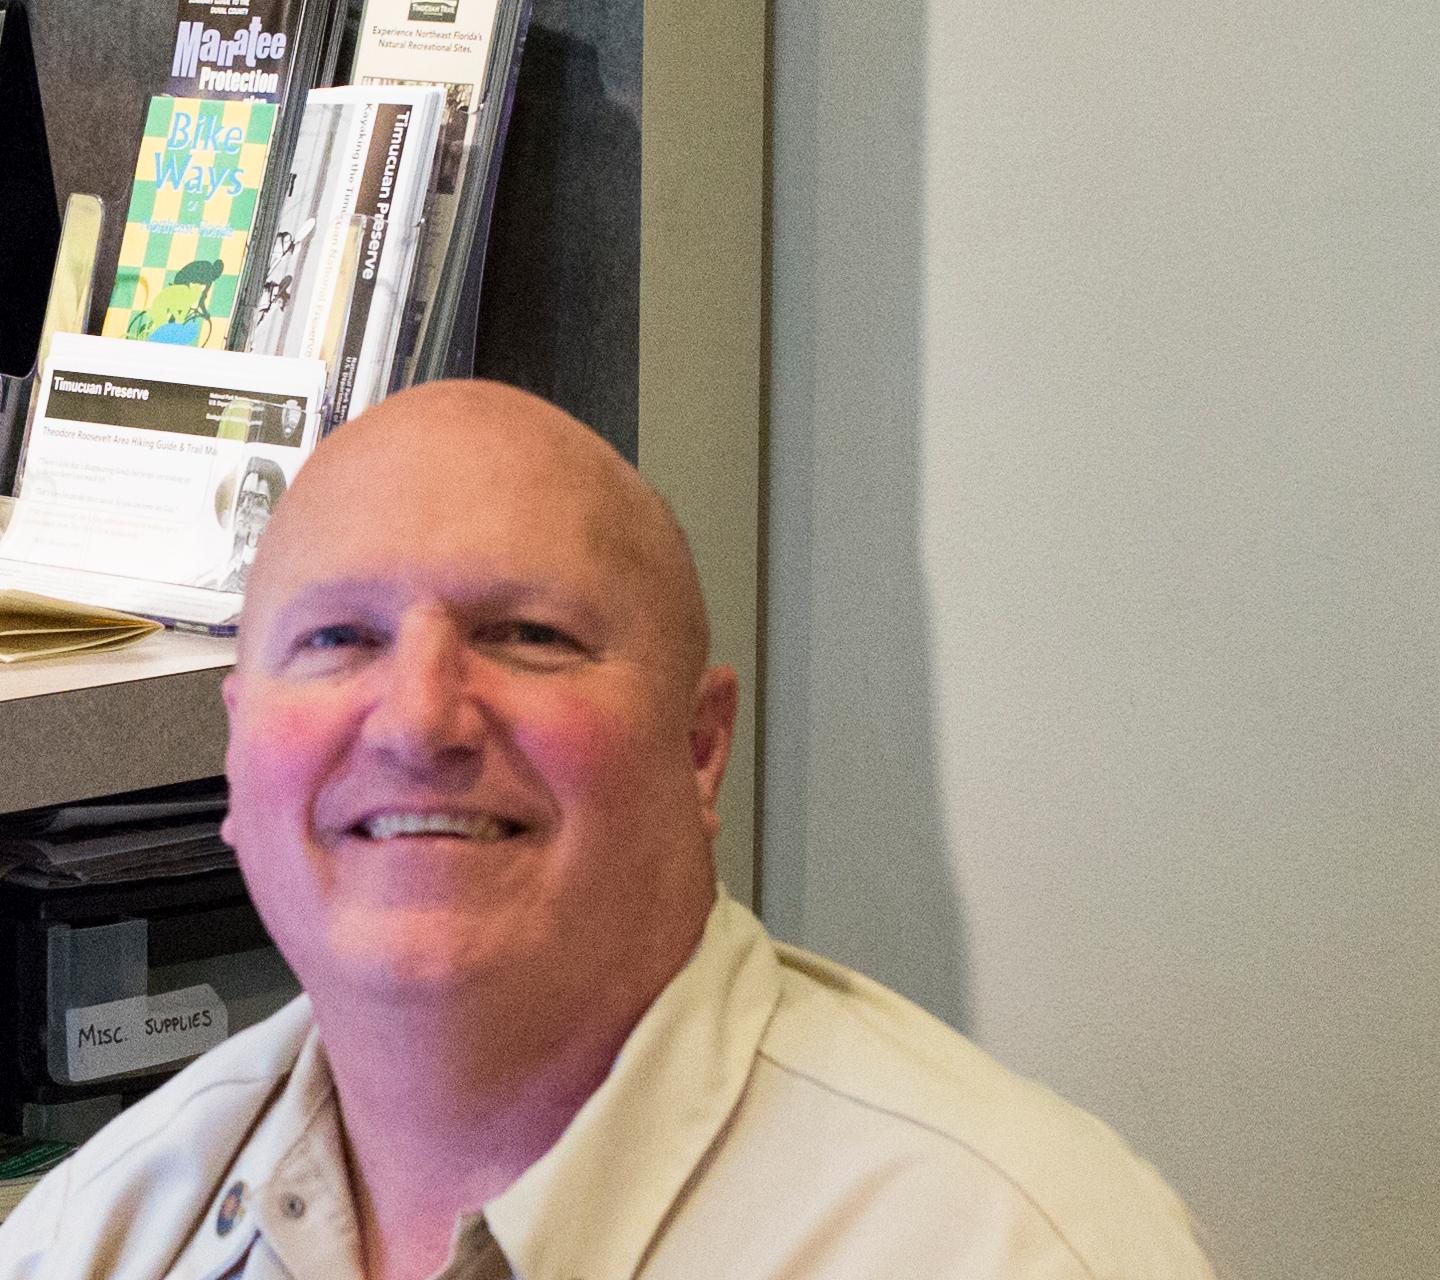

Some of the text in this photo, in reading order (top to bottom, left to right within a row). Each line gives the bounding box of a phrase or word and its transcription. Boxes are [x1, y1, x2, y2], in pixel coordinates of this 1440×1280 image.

[171, 16, 287, 78] Manatee
[371, 25, 483, 42] Experience Northeast Florida's
[377, 38, 473, 55] Natural Recreational Sites.
[198, 66, 280, 95] Protection
[167, 112, 245, 155] Bike
[351, 103, 374, 160] Kayaking
[153, 151, 245, 203] Ways
[348, 163, 360, 184] the
[361, 110, 411, 280] Timucuan Preserve
[53, 375, 150, 401] Timucuan Preserve
[42, 425, 76, 441] Theodore
[77, 430, 112, 445] Roosevelt
[112, 433, 131, 447] Area
[131, 436, 155, 451] Hiking
[155, 438, 178, 452] Guide
[186, 442, 203, 455] Trail
[144, 1009, 213, 1035] SUPPLIES
